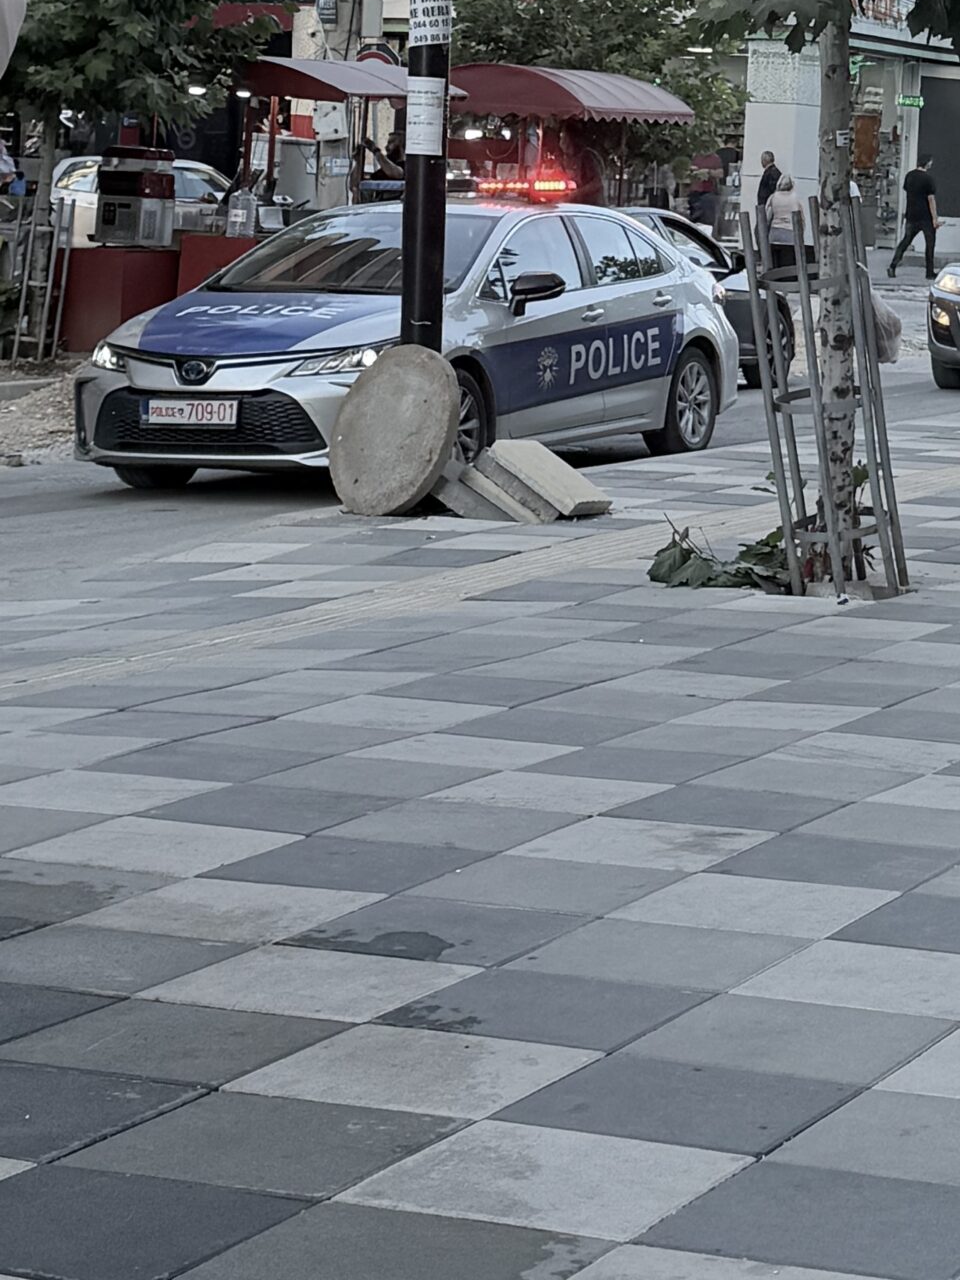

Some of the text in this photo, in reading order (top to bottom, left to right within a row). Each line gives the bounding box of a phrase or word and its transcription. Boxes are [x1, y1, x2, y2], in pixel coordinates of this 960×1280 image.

[175, 304, 346, 319] POLICE
[568, 326, 661, 385] POLICE
[150, 402, 234, 422] POLICE 709-01
